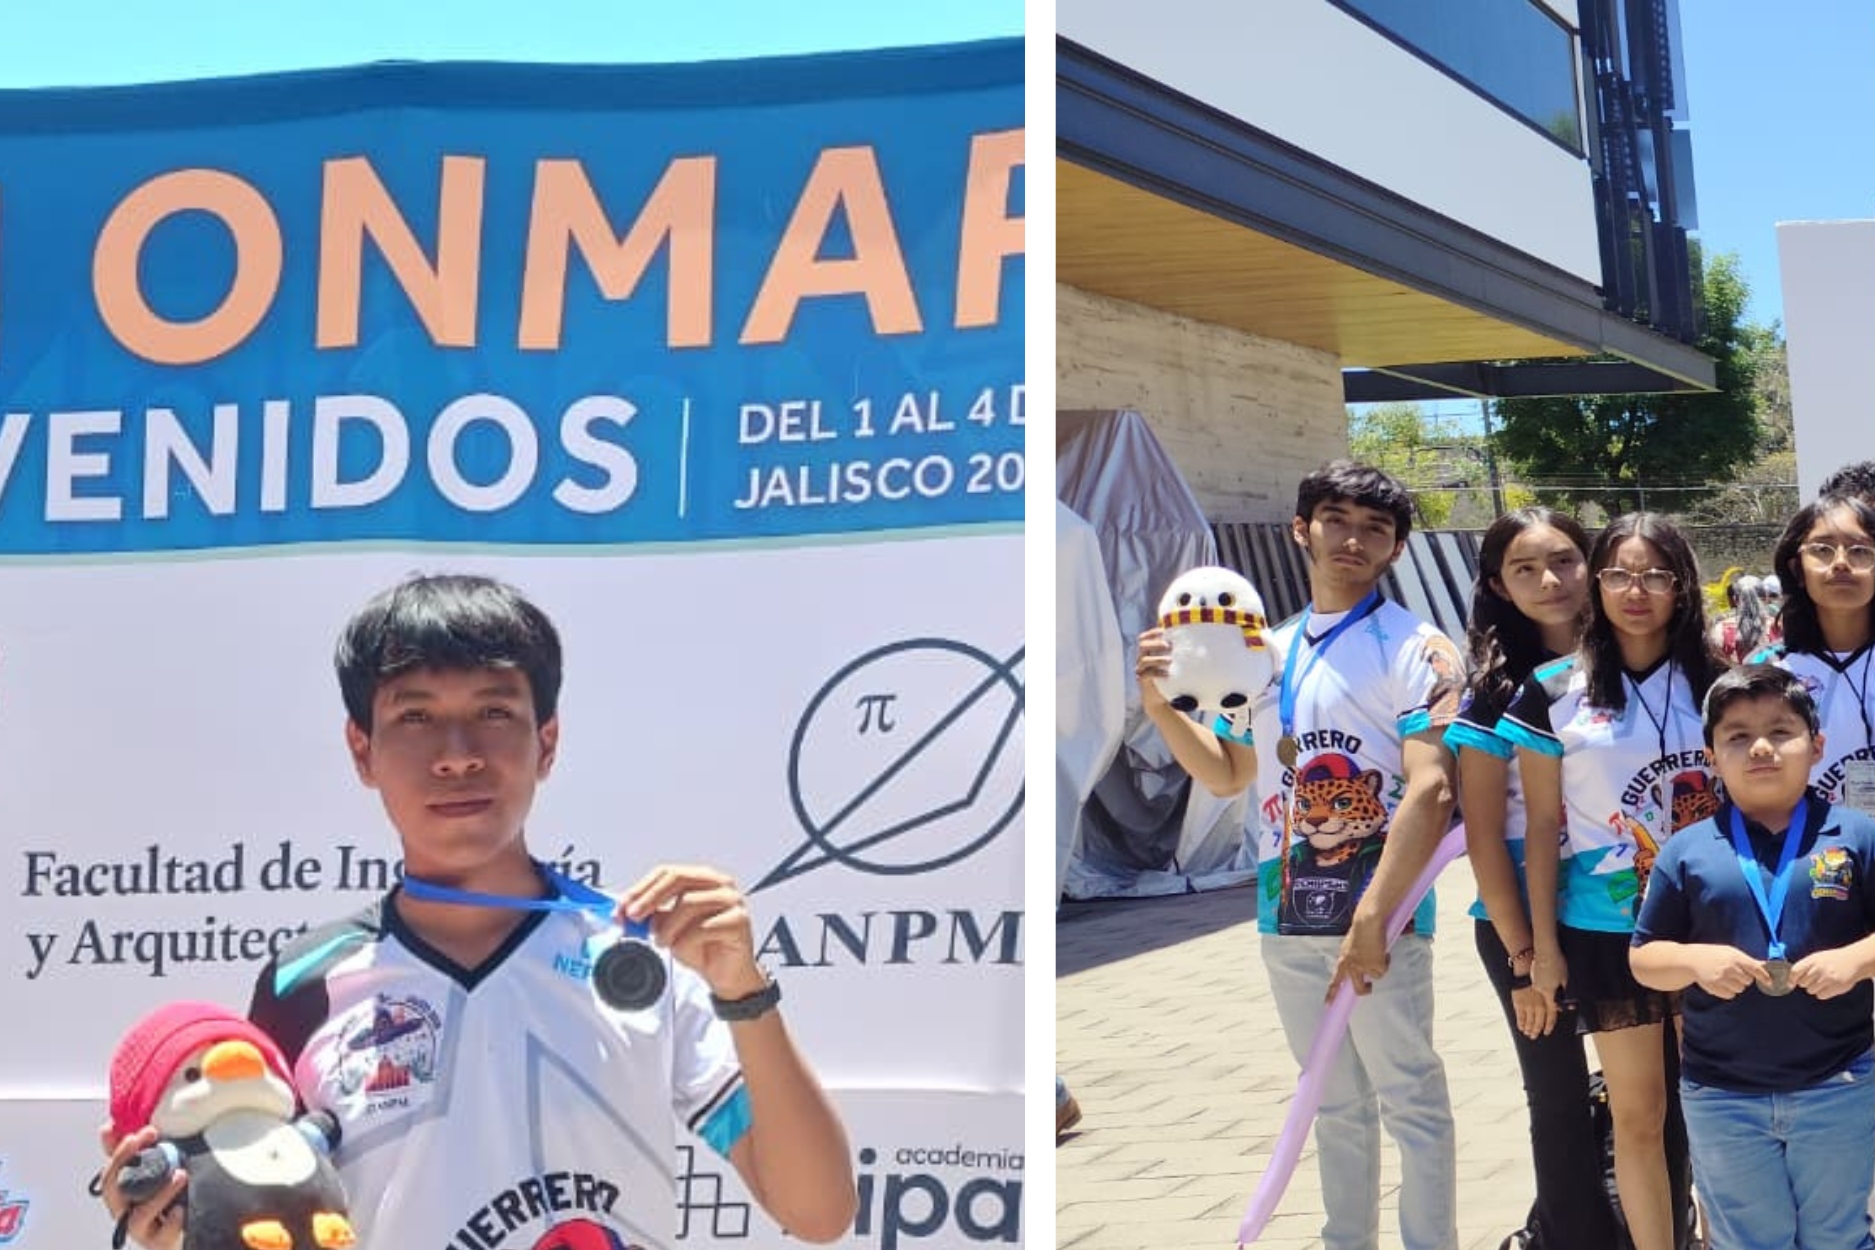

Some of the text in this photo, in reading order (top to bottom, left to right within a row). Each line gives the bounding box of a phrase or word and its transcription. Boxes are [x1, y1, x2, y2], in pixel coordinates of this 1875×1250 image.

[738, 401, 837, 444] DEL
[853, 398, 875, 437] 1
[889, 390, 955, 435] AL
[966, 387, 996, 428] 4
[735, 455, 955, 510] JALISCO
[21, 841, 246, 898] Facultad
[259, 842, 321, 892] de
[25, 930, 58, 981] y
[755, 910, 1025, 967] ANPM
[896, 1145, 1025, 1170] academia
